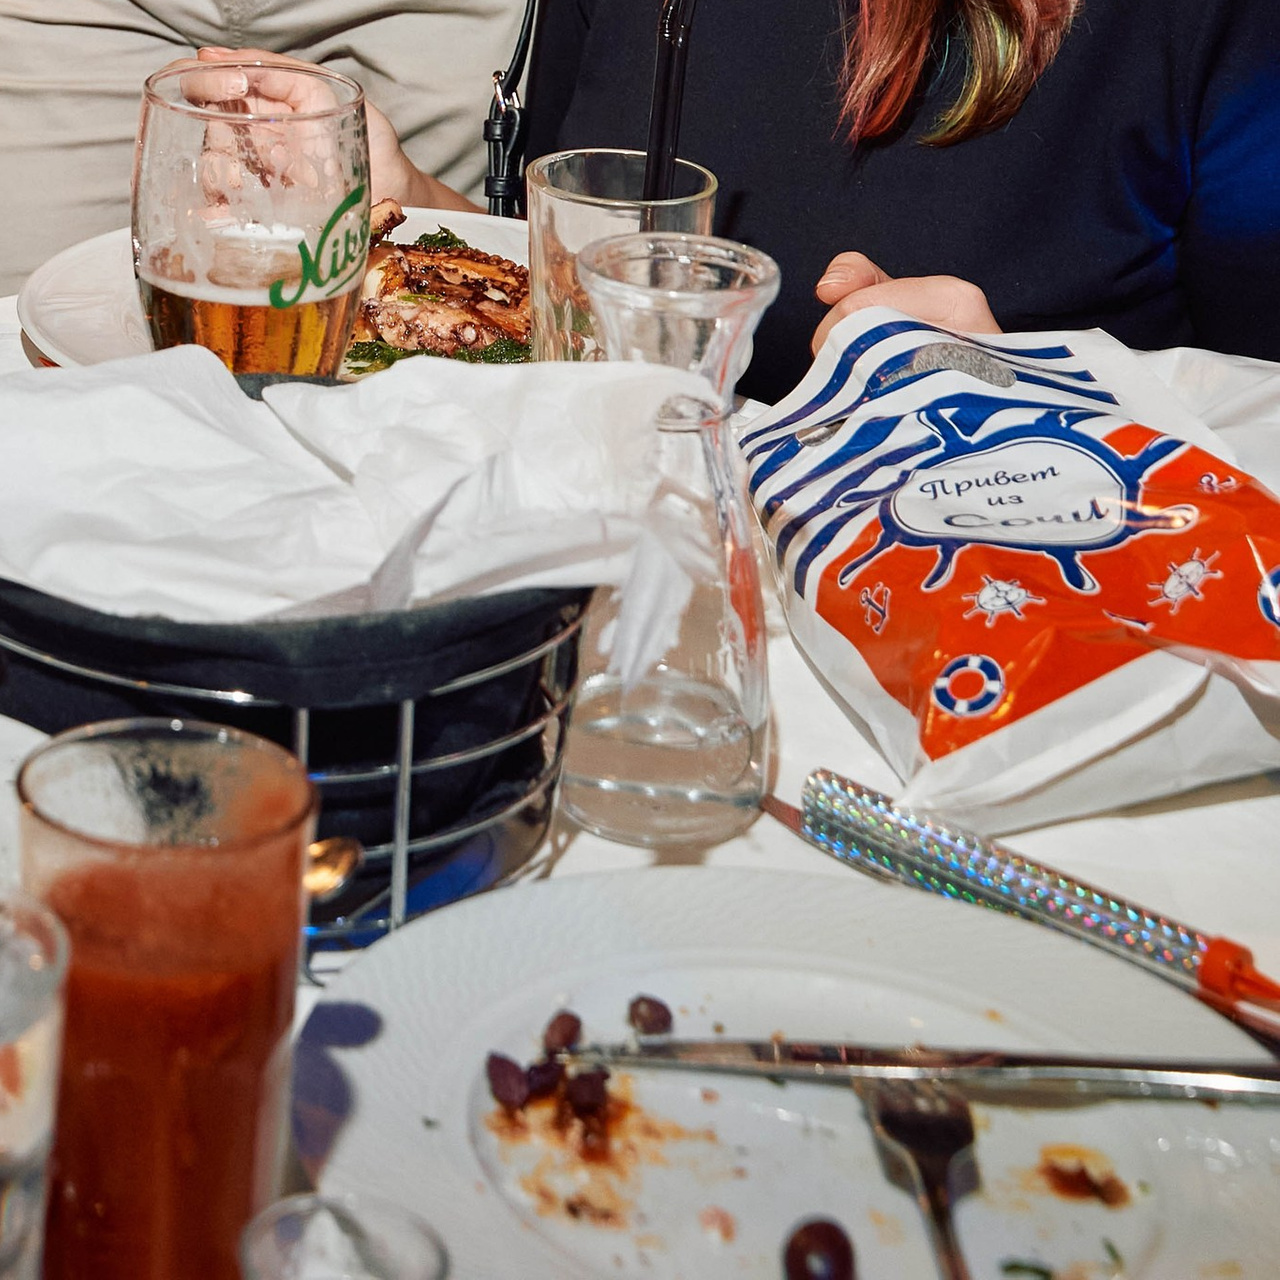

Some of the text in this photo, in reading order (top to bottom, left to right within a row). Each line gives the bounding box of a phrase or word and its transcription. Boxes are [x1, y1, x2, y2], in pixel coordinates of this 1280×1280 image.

[920, 466, 1060, 500] Привет
[943, 497, 1109, 528] Сочи
[987, 494, 1024, 506] из
